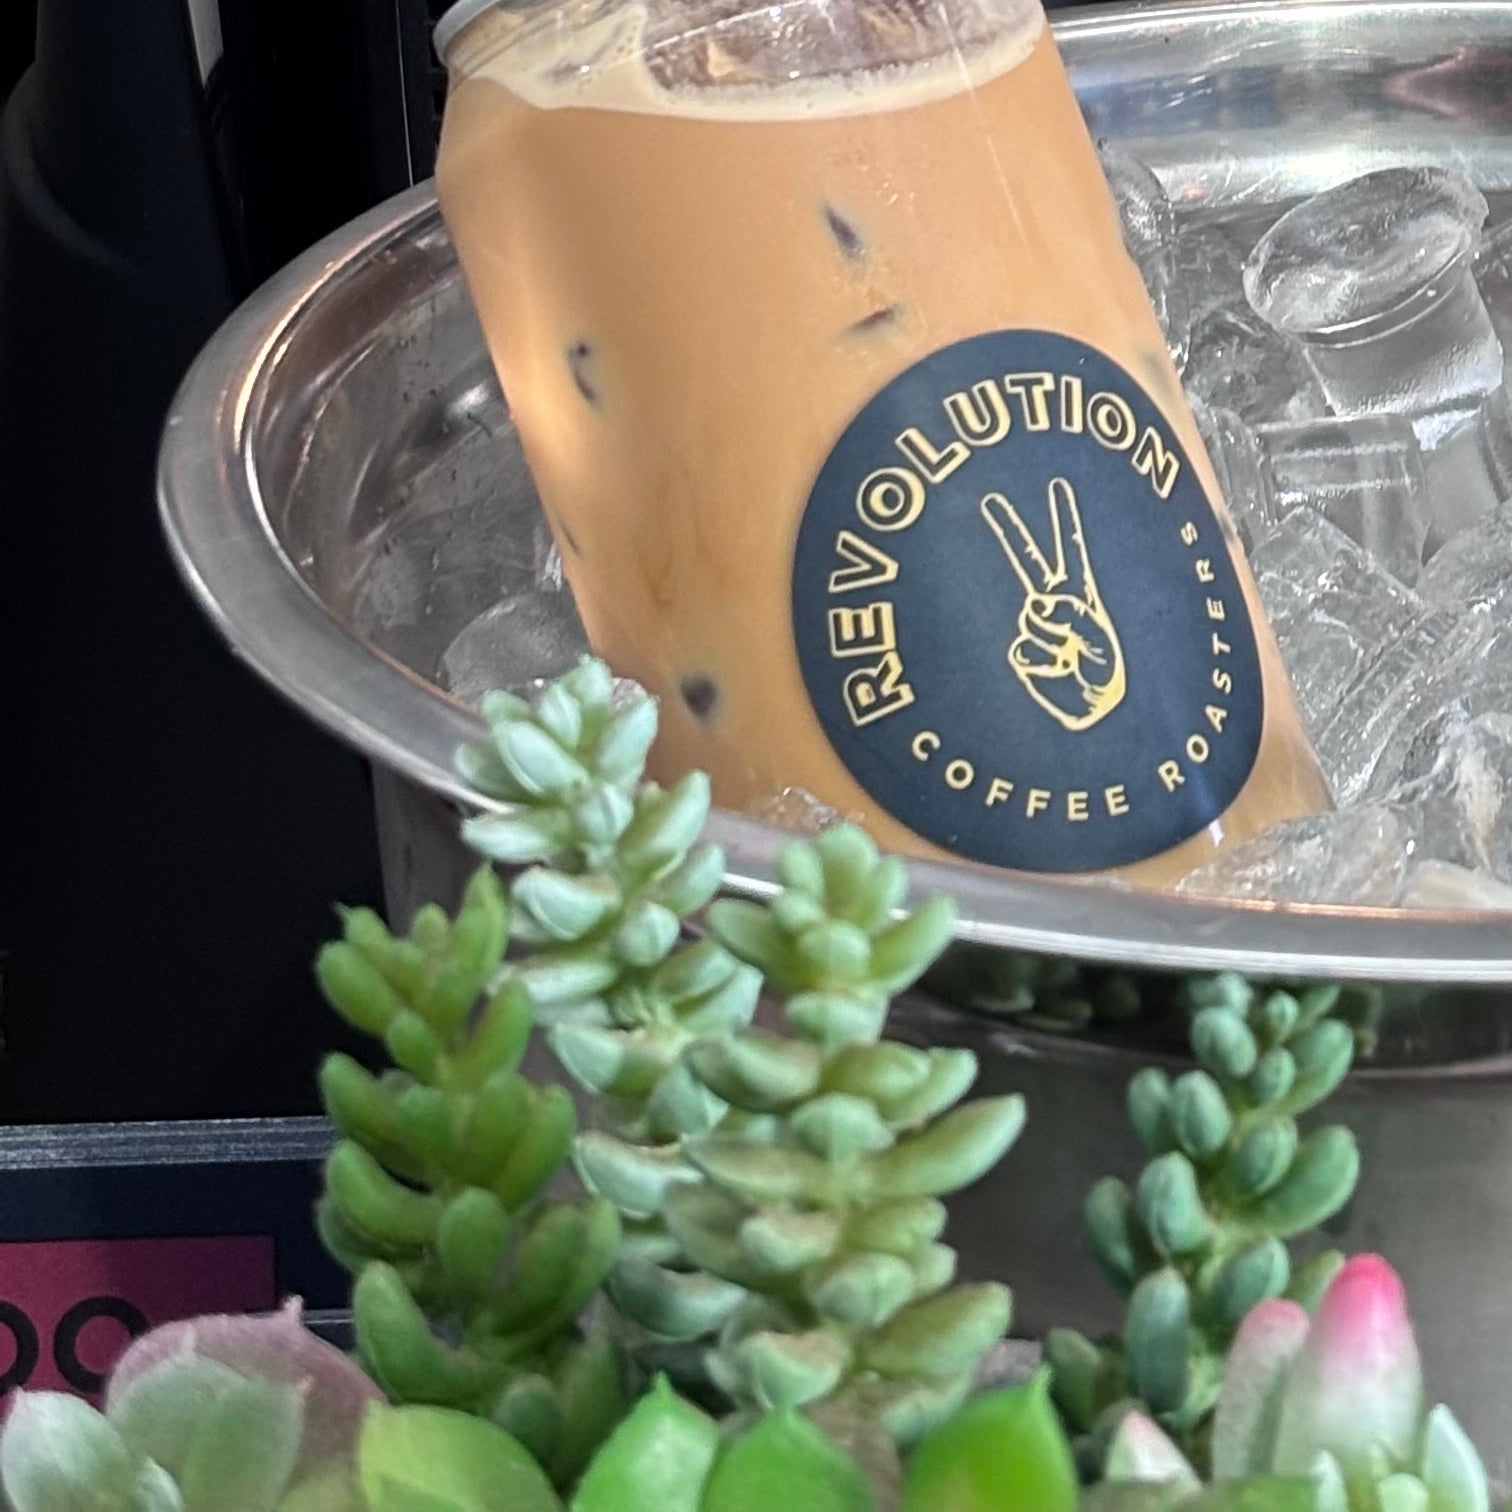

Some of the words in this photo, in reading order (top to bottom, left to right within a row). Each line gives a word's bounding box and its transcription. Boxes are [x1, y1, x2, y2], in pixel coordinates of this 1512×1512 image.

[828, 372, 1181, 726] REVOLUTION
[910, 730, 1131, 821] COFFEE
[1157, 521, 1233, 792] ROASTERS
